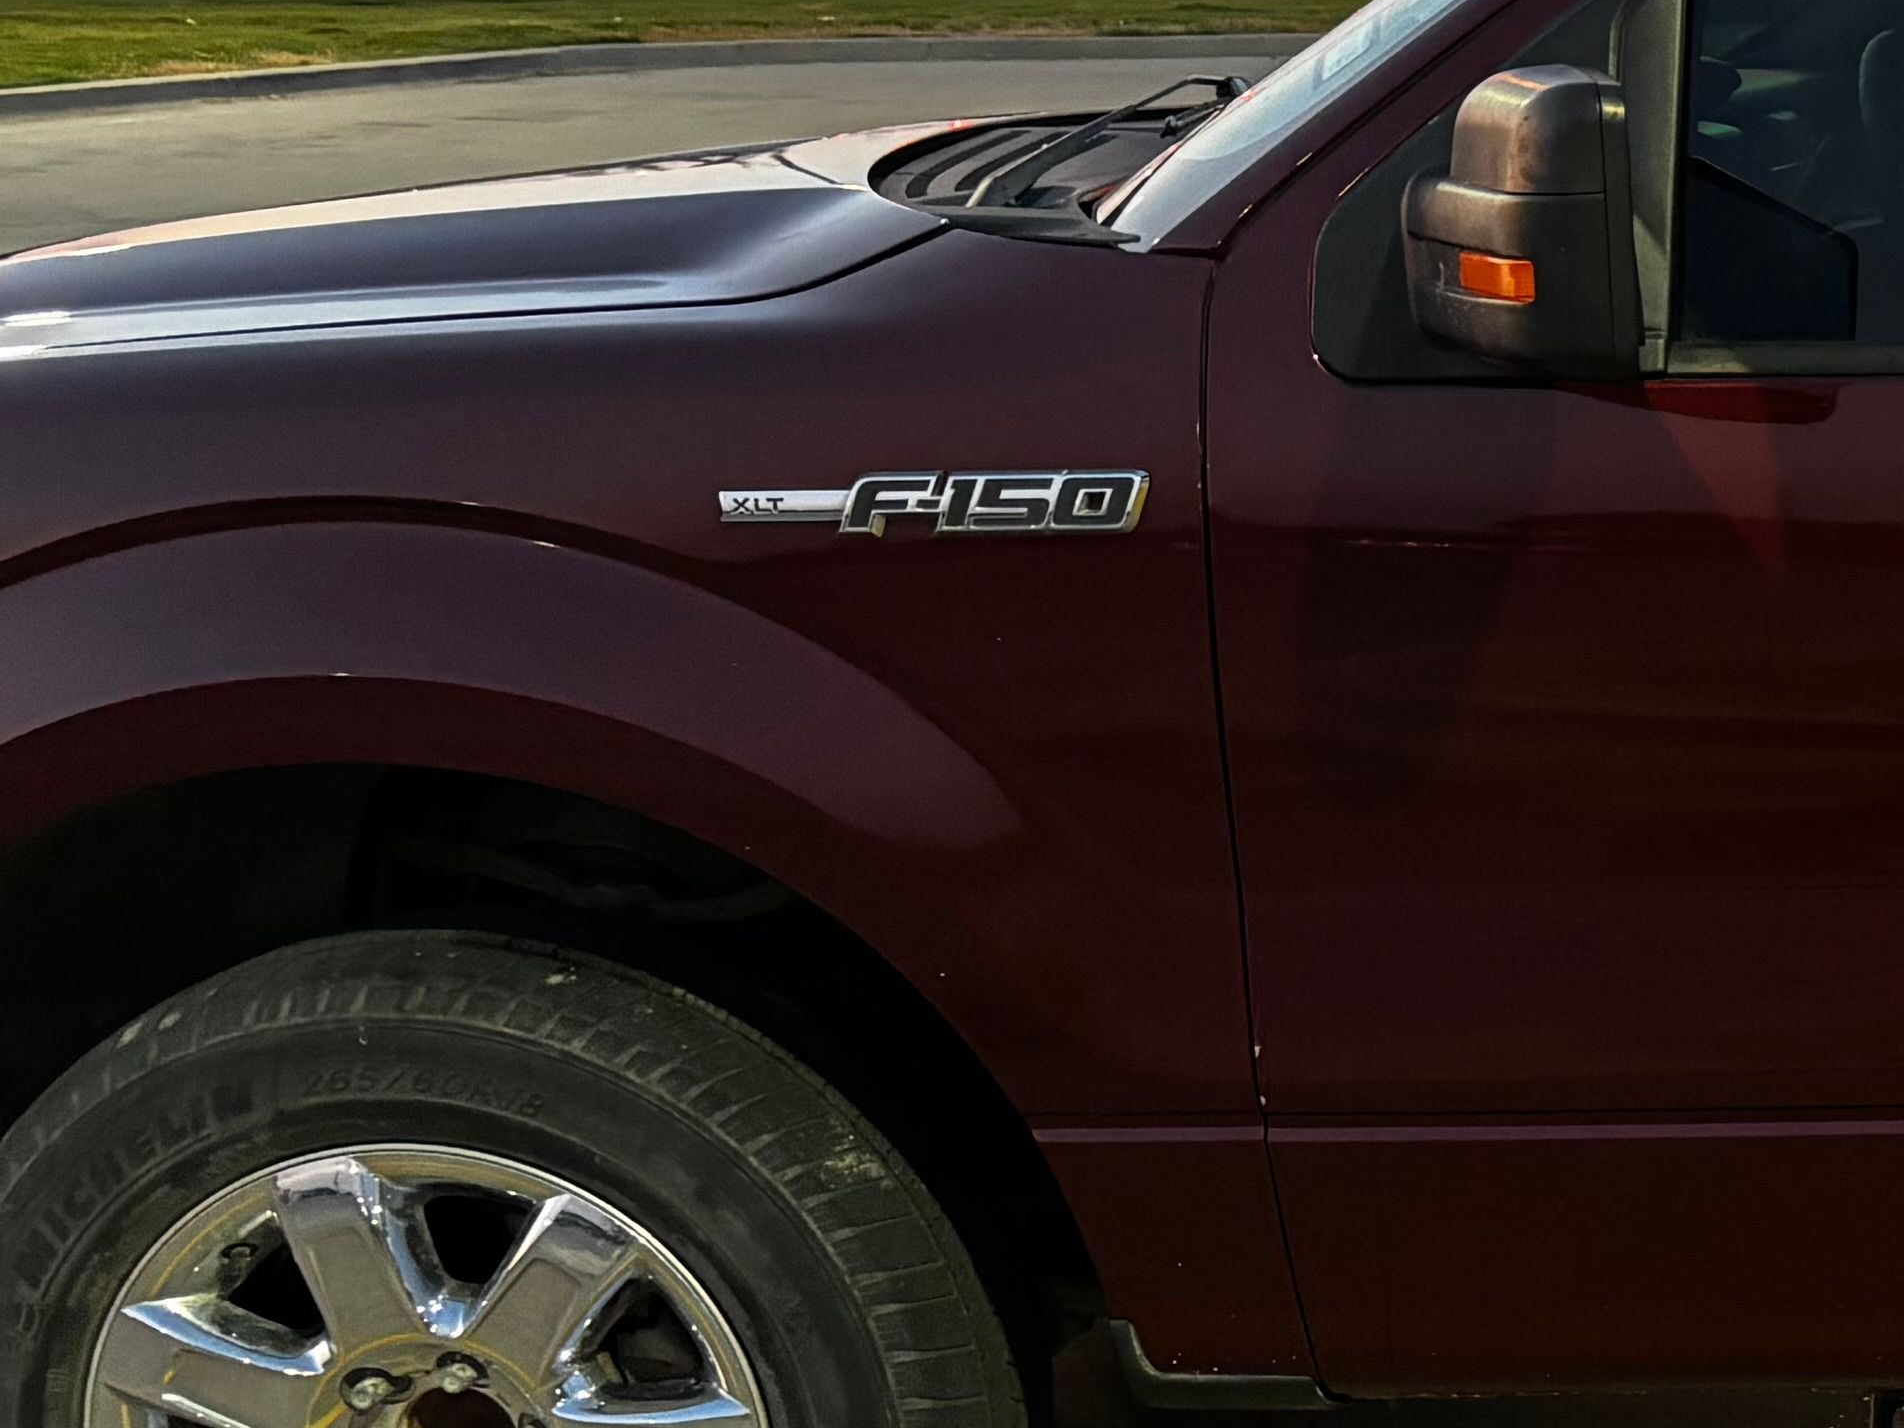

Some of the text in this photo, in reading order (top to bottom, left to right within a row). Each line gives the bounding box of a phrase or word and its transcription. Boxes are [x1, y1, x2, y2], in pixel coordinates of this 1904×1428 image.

[728, 495, 785, 516] XLT
[840, 470, 1150, 537] F-150
[8, 1076, 256, 1288] MICHELIN
